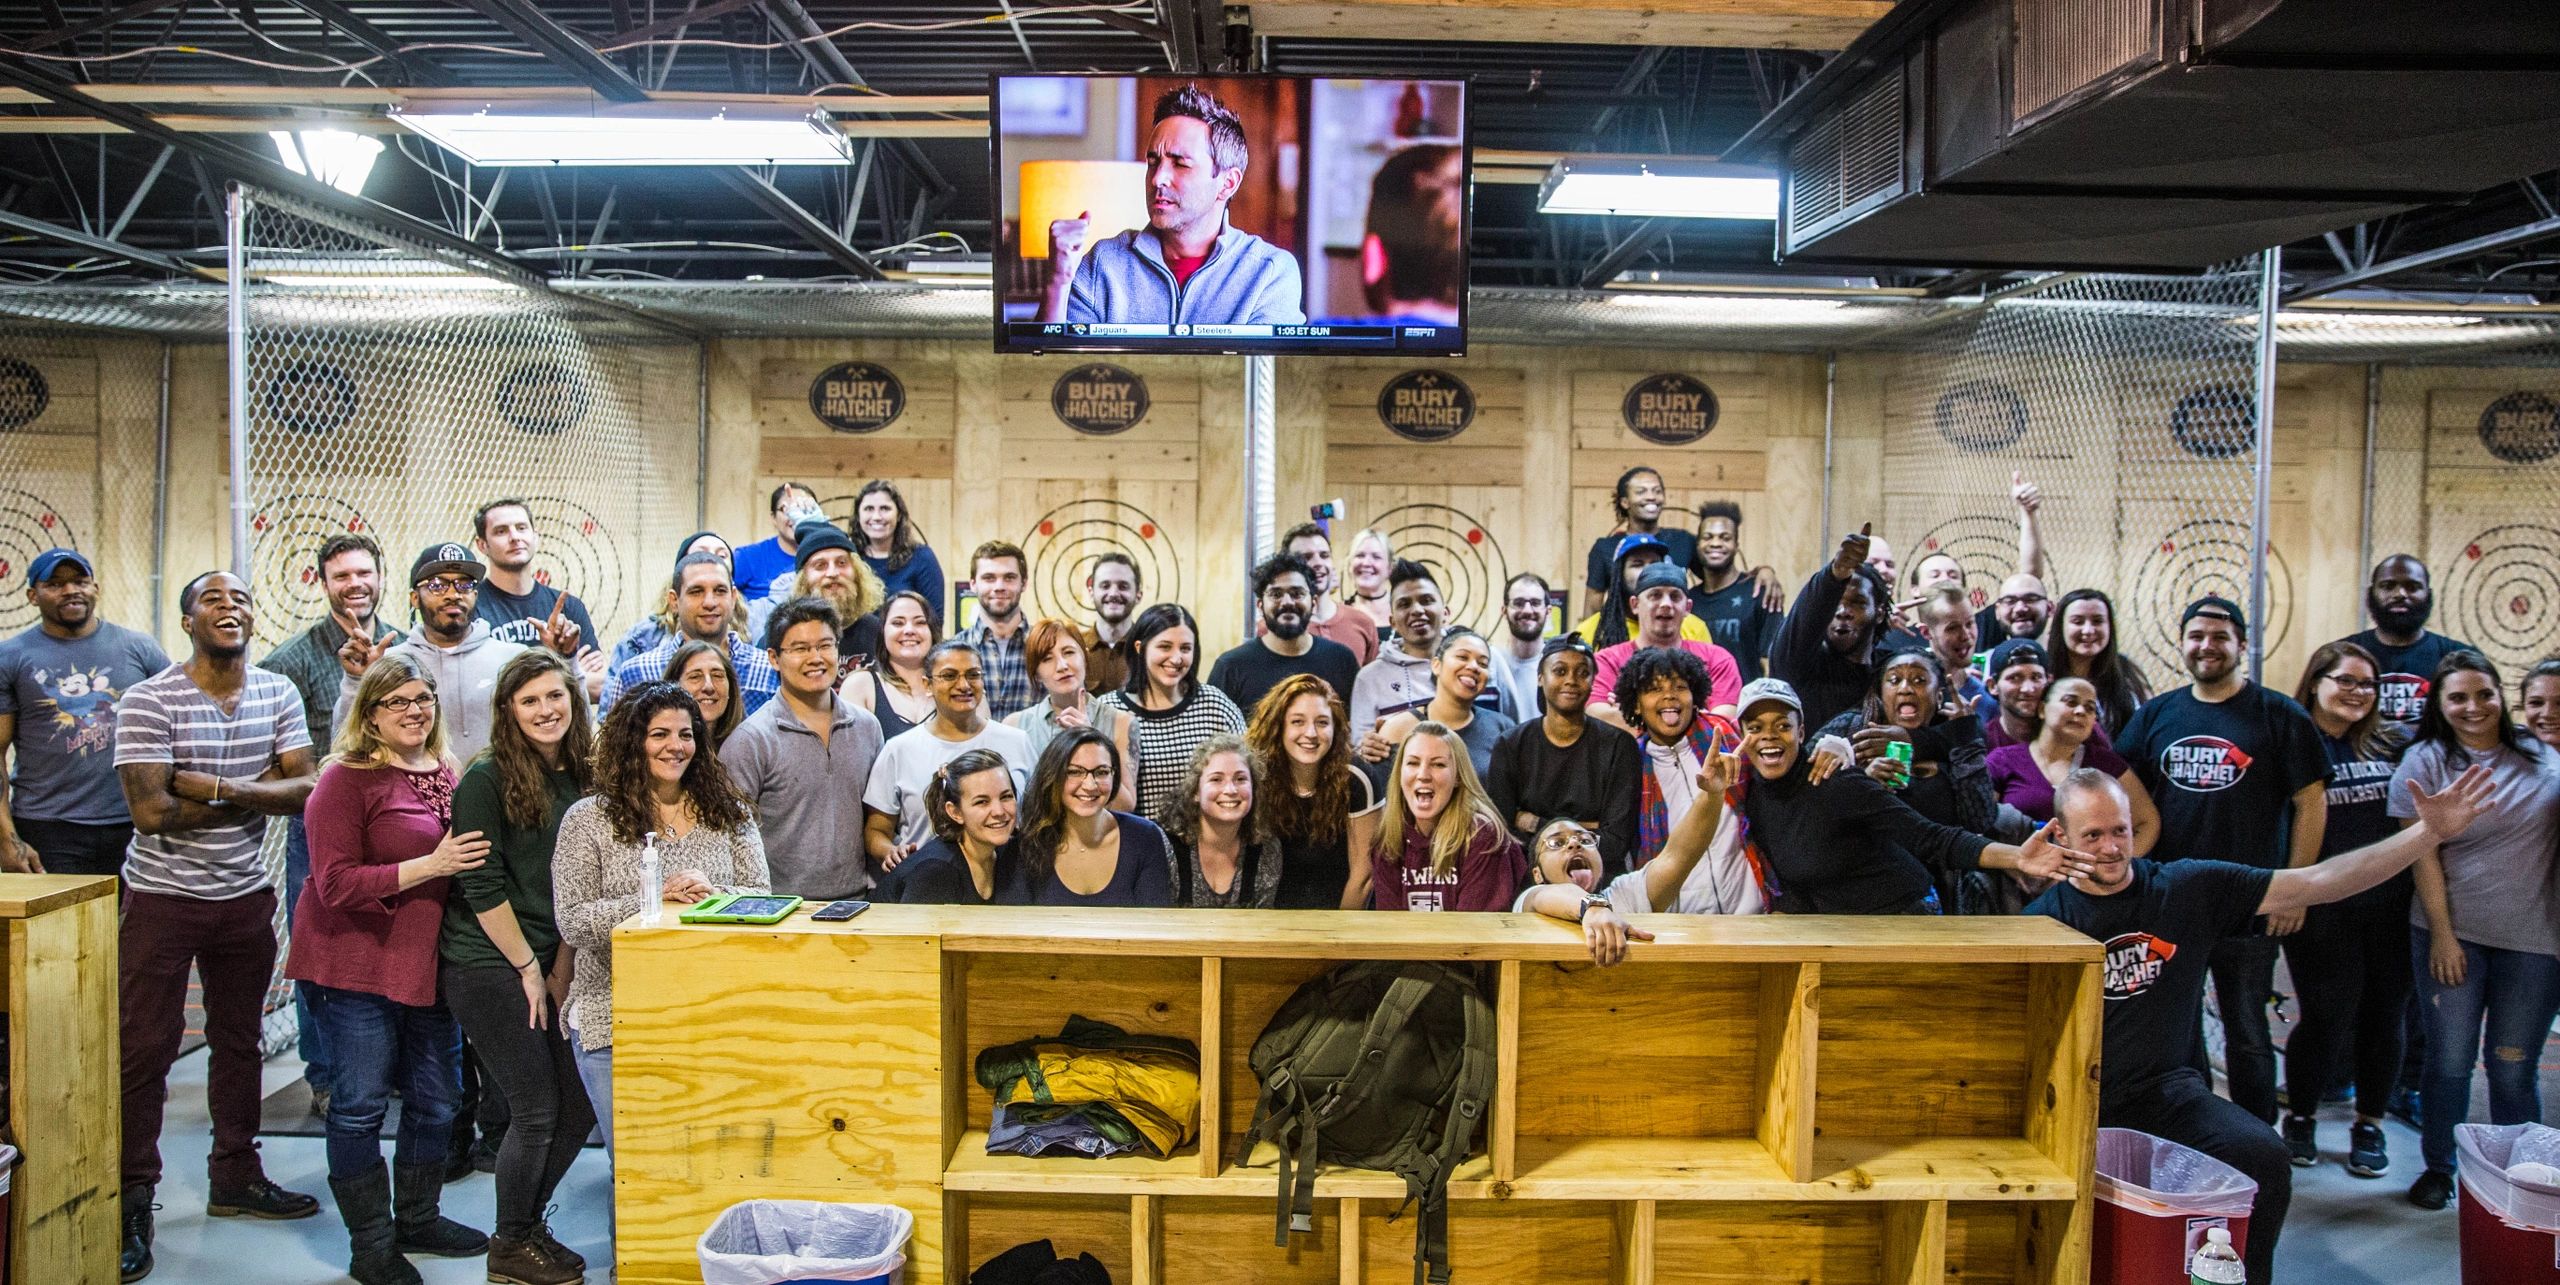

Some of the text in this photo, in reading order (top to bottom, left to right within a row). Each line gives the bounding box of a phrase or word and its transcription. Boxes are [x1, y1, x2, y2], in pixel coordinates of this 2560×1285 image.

[1043, 325, 1331, 336] AFC Jaguars Steelers 1:05 ET SUN
[1404, 327, 1436, 337] ESPN
[825, 380, 888, 399] BURY
[1068, 382, 1132, 401] BURY
[1394, 388, 1459, 407] BURY
[827, 399, 894, 418] HATCHET
[1068, 400, 1137, 419] HATCHET
[1640, 393, 1703, 411] BURY
[1394, 406, 1463, 426] HATCHET
[1640, 410, 1708, 430] HATCHET
[2379, 682, 2422, 699] URY
[2169, 745, 2230, 765] BURY
[2172, 762, 2237, 782] HATCHET
